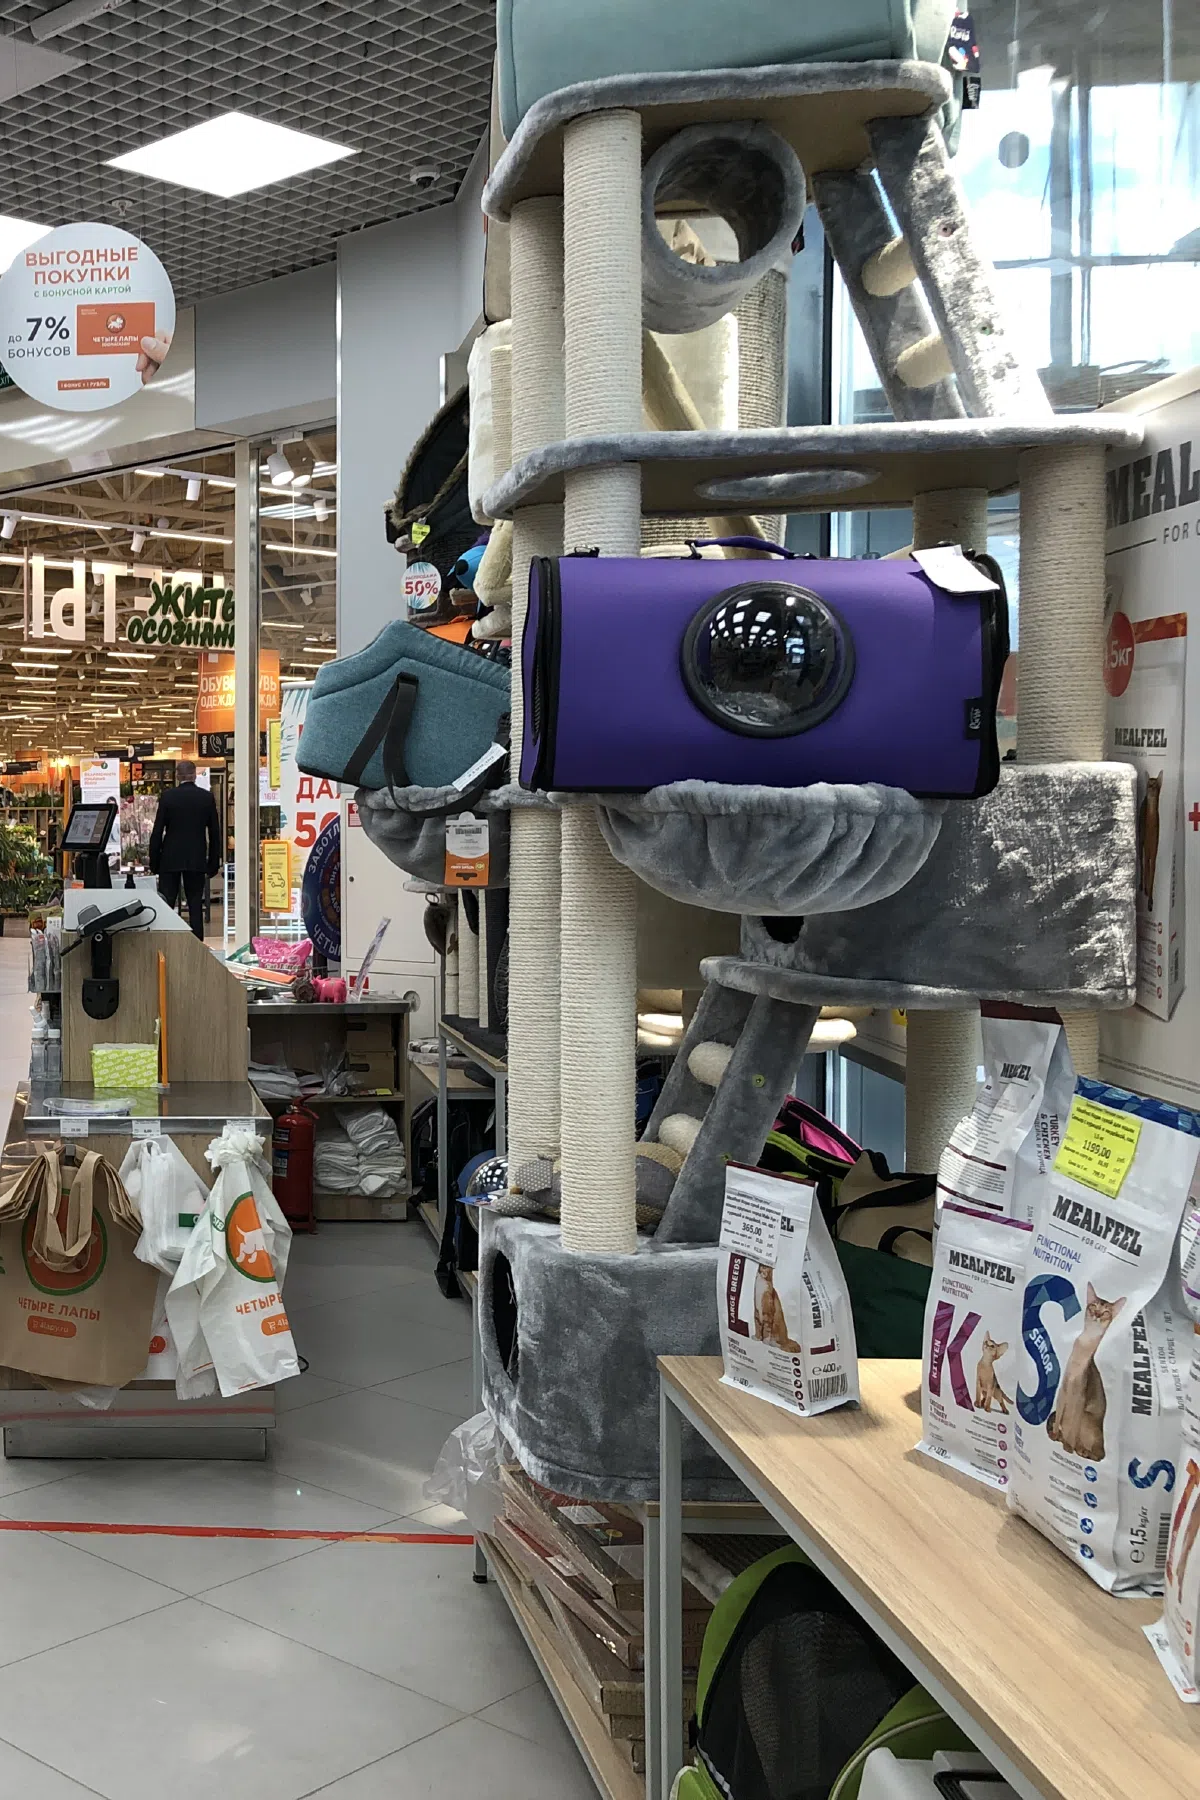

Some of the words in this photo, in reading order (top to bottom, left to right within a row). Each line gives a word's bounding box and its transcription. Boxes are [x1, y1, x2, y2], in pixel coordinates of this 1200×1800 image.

[25, 247, 139, 267] ВЫГОДНЫЕ
[34, 266, 130, 285] ПОКУПКИ
[42, 287, 93, 298] БОНУСНОЙ
[94, 285, 132, 295] КАРТОЙ
[26, 315, 70, 342] 7%
[8, 346, 71, 359] БОНУСОВ
[1163, 525, 1190, 544] FOR
[405, 580, 439, 597] 50%
[1114, 727, 1168, 748] MEALFEEL
[1050, 1113, 1060, 1147] TURKEY
[1041, 1121, 1052, 1161] CHICKEN
[1082, 1139, 1112, 1160] 1199,00
[741, 1222, 762, 1237] 365,00
[1052, 1194, 1144, 1258] MEALFEEL
[1036, 1234, 1083, 1264] FUNCTIONAL
[1081, 1236, 1095, 1247] FOR
[1094, 1242, 1107, 1254] CATS
[949, 1249, 1016, 1285] MEALFEEL
[1033, 1246, 1073, 1273] NUTRITION
[730, 1258, 742, 1293] BREEDS
[942, 1277, 974, 1294] FUNCTIONAL
[941, 1285, 969, 1300] NUTRITION
[18, 1296, 55, 1315] ЧЕТЫРЕ
[58, 1305, 101, 1322] ЛАПЫ
[931, 1338, 942, 1379] KITTEN
[1028, 1328, 1054, 1375] SENIOR
[822, 1362, 836, 1373] 400
[1130, 1527, 1149, 1545] 1,5
